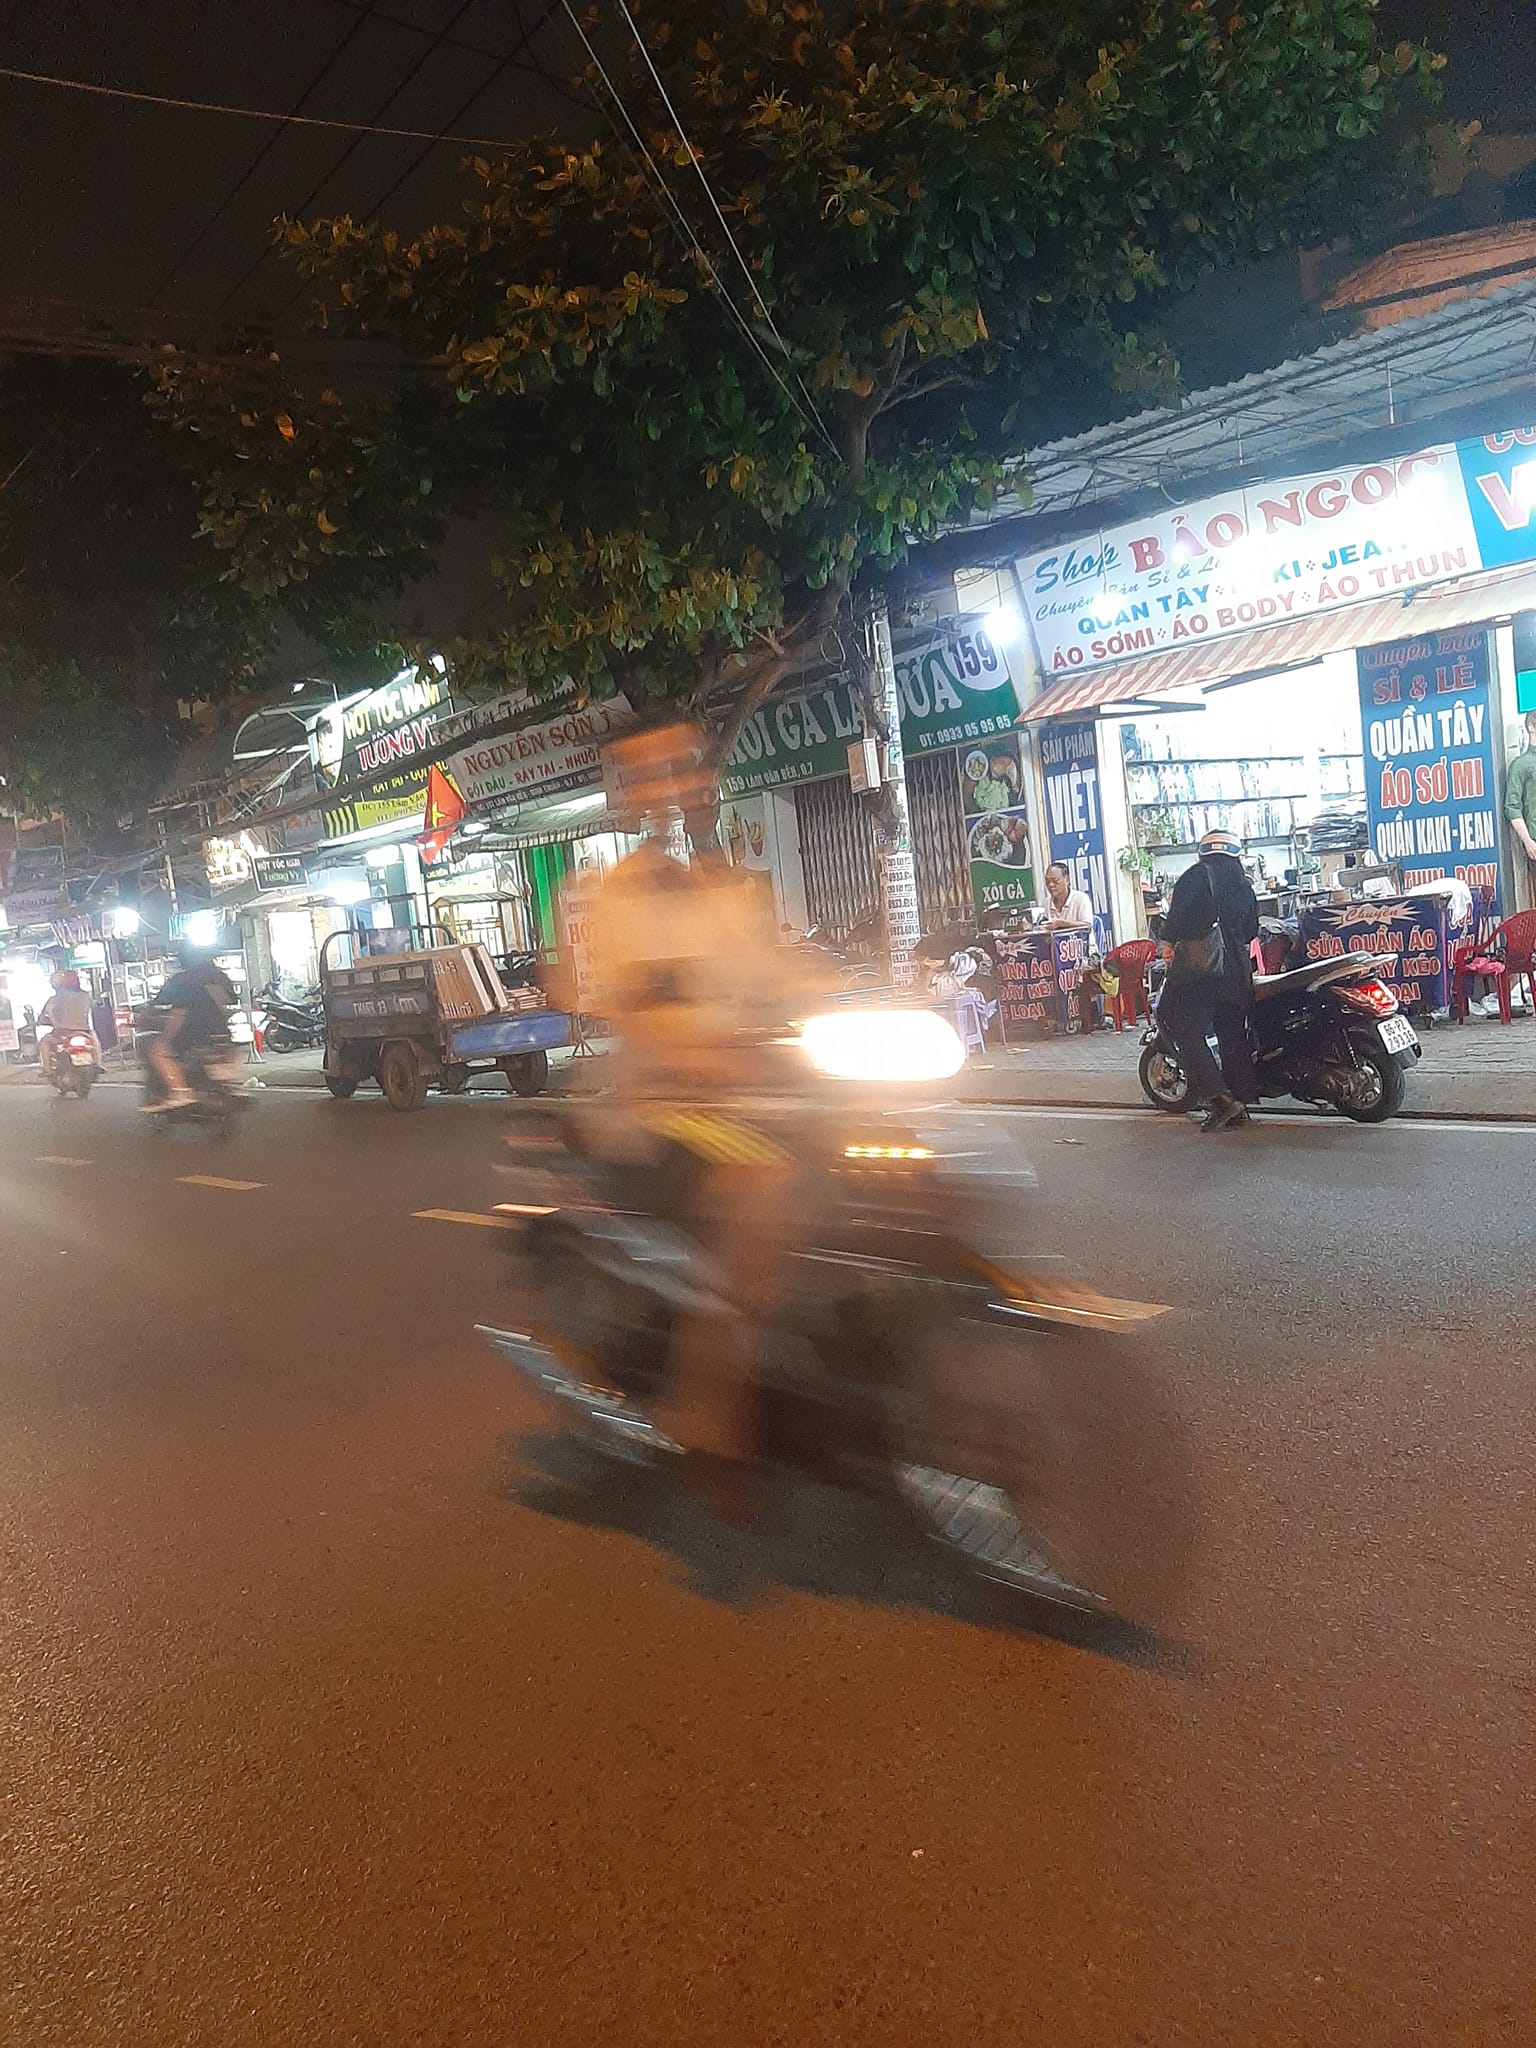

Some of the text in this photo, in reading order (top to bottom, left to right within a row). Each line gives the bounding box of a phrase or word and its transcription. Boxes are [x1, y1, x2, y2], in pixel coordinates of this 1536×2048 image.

[1034, 542, 1121, 594] Shop
[1127, 513, 1244, 574] BẢO
[1176, 562, 1191, 580] &
[1156, 584, 1210, 614] TÂY
[1321, 539, 1398, 571] JEA
[1052, 645, 1084, 670] ÁO
[1172, 613, 1209, 640] ÁO
[1216, 590, 1296, 629] BODY
[1317, 575, 1361, 604] ÁO
[1368, 547, 1468, 588] THUN
[947, 631, 998, 680] 159
[1409, 674, 1428, 702] &
[1435, 655, 1477, 695] LẺ
[936, 726, 964, 744] 0933
[979, 718, 996, 734] 95
[1369, 699, 1485, 761] QUẦN TÂY
[1042, 733, 1065, 765] SẢN
[536, 760, 557, 777] TAI
[725, 775, 746, 793] 159
[1381, 756, 1484, 809] ÁO SƠ MI
[1046, 761, 1098, 841] VIỆT
[1376, 810, 1415, 862] QUẦN
[1415, 815, 1452, 855] KAKI
[1458, 810, 1495, 851] JEAN
[981, 877, 1026, 904] XÔI GÀ
[1054, 842, 1109, 915] IẾN
[1343, 903, 1401, 925] Chuyên
[1306, 924, 1438, 960] SỬA QUẦN ÁO
[1030, 957, 1055, 980] ÁO
[1402, 955, 1442, 978] KÉO
[1010, 1001, 1046, 1021] LOẠI
